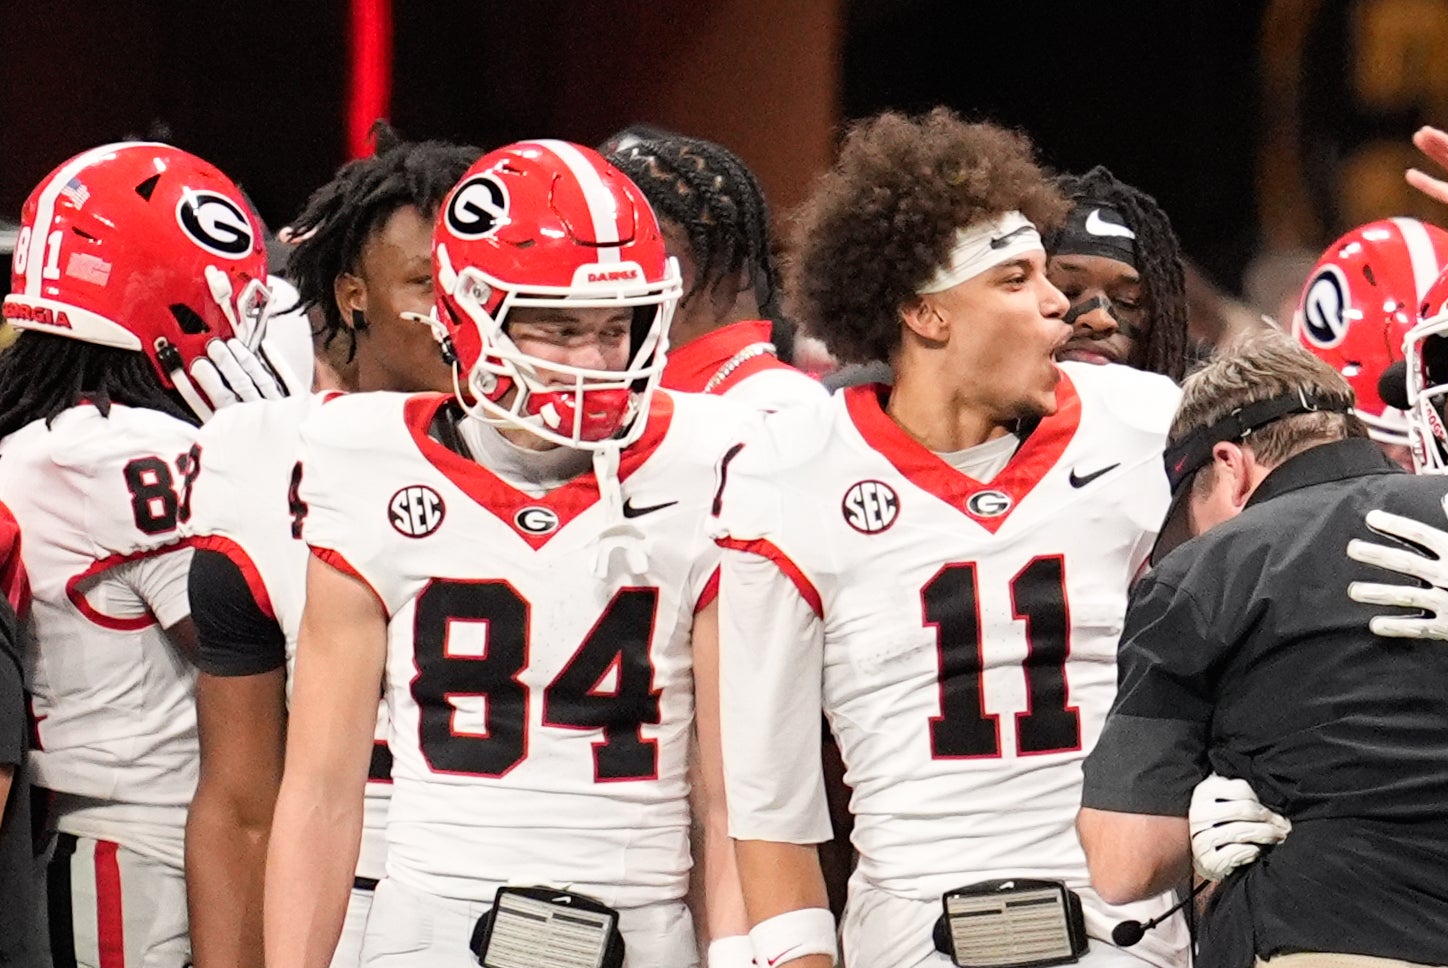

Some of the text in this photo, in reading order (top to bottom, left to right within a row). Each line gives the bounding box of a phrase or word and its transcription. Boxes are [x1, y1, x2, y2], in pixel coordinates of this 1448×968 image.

[178, 193, 252, 255] G
[447, 176, 506, 236] G
[390, 486, 444, 537] SEC
[514, 508, 559, 533] G
[844, 480, 898, 533] SEC
[967, 491, 1011, 516] G
[409, 577, 663, 784] 84
[920, 554, 1083, 760] 11
